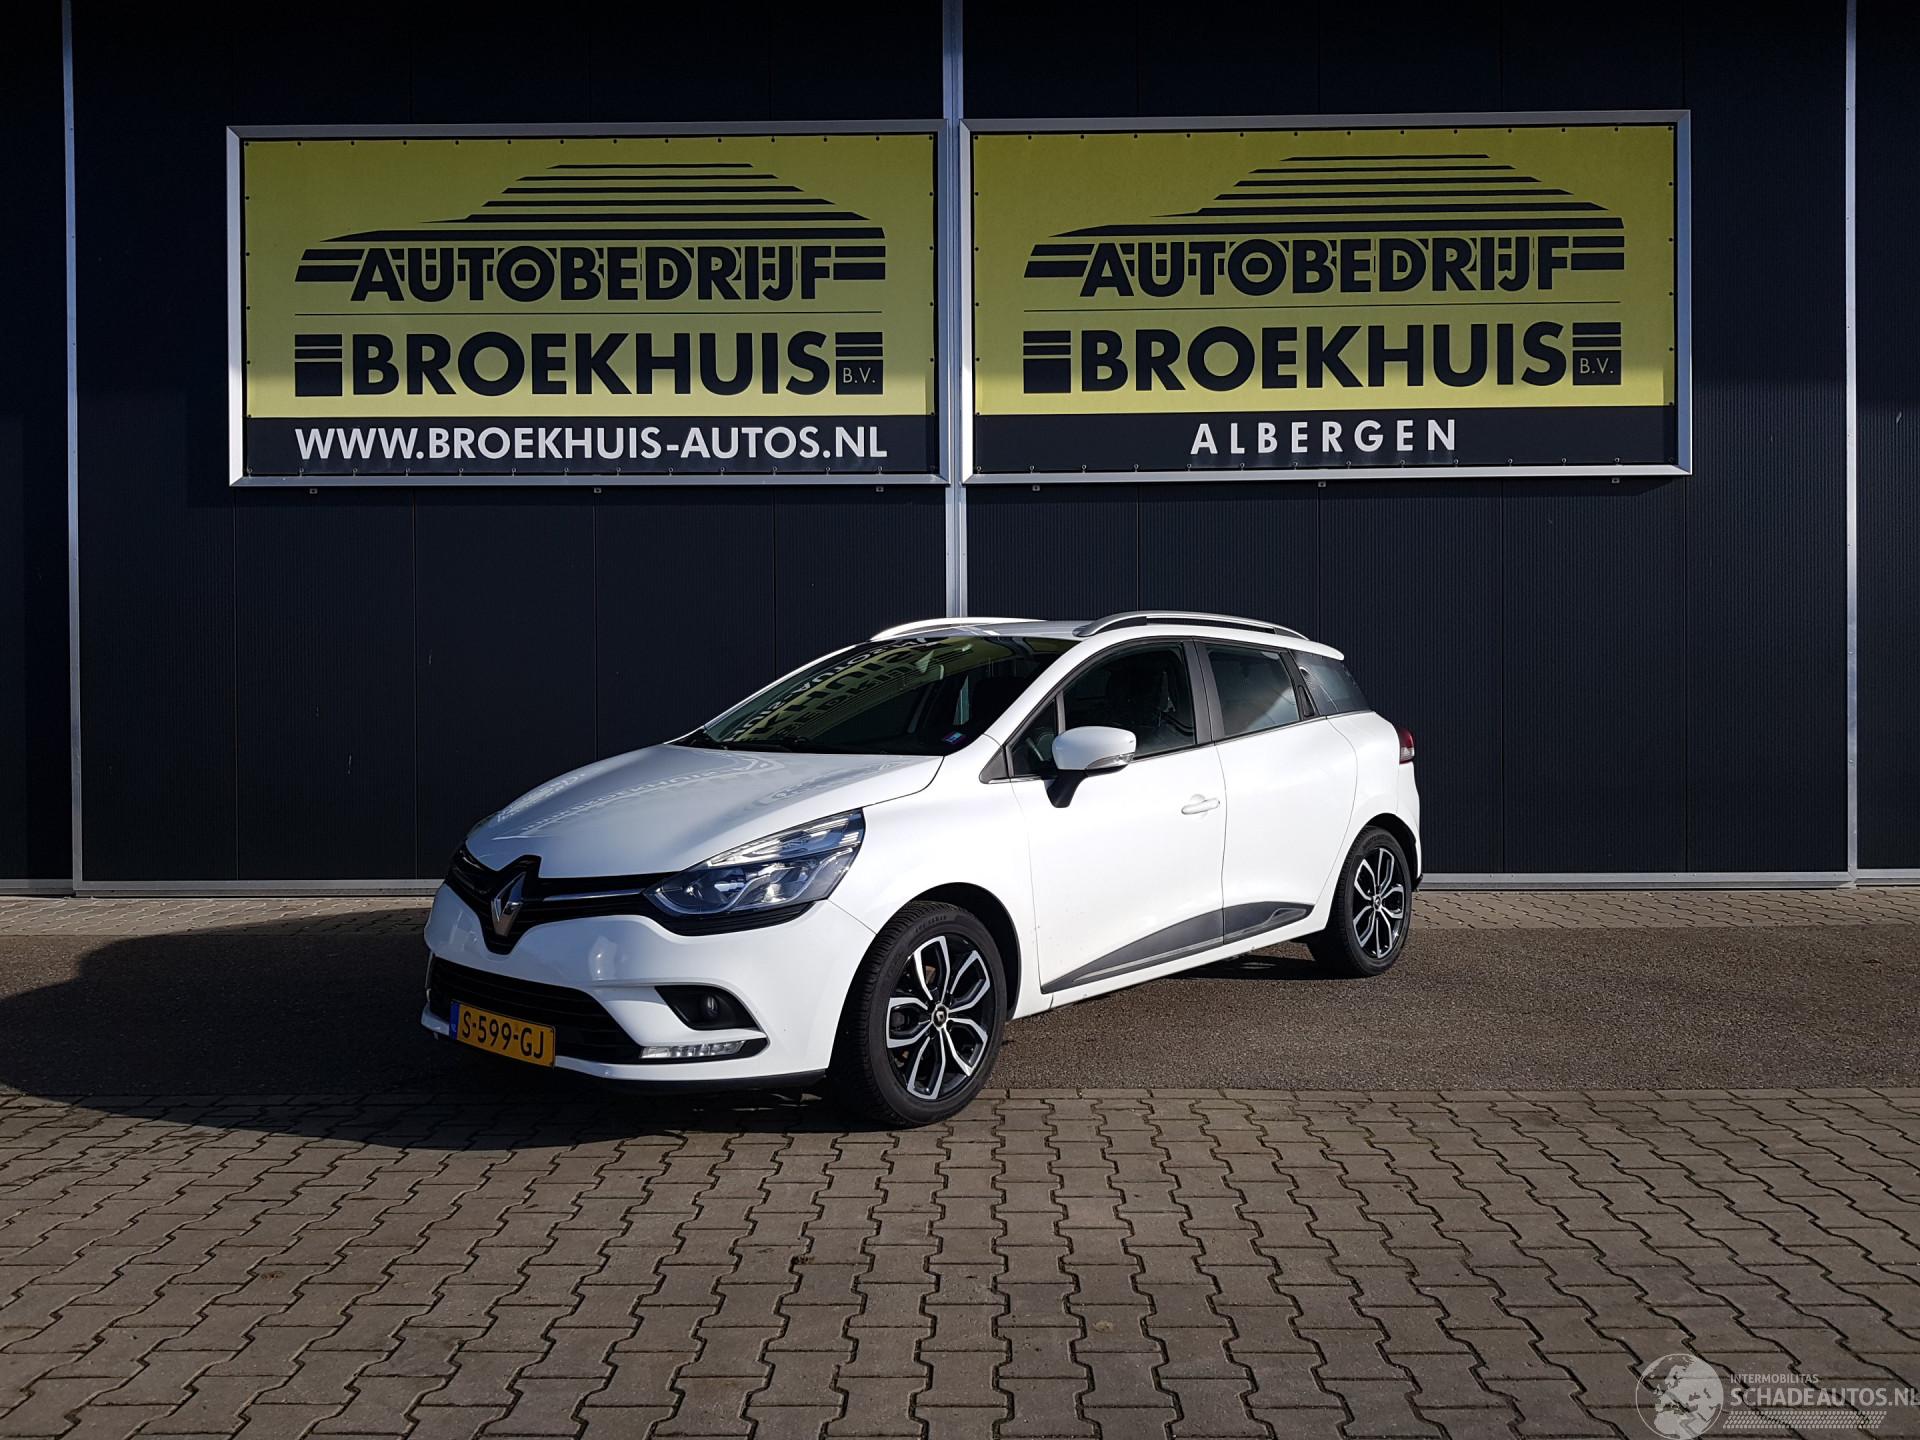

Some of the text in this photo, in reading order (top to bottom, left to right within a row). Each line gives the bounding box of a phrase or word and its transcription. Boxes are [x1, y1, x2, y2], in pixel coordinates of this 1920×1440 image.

[351, 245, 832, 302] AUTOBEDRIJF
[1080, 236, 1569, 296] AUTOBEDRIJF
[353, 331, 876, 396] BROEKHUIS B.V.
[1081, 322, 1614, 391] BROEKHUIS B.V.
[296, 427, 888, 459] WWW.BROEKHUIS-AUTOS.NL
[1191, 419, 1455, 454] ALBERGEN
[462, 1012, 544, 1058] S-599-GJ
